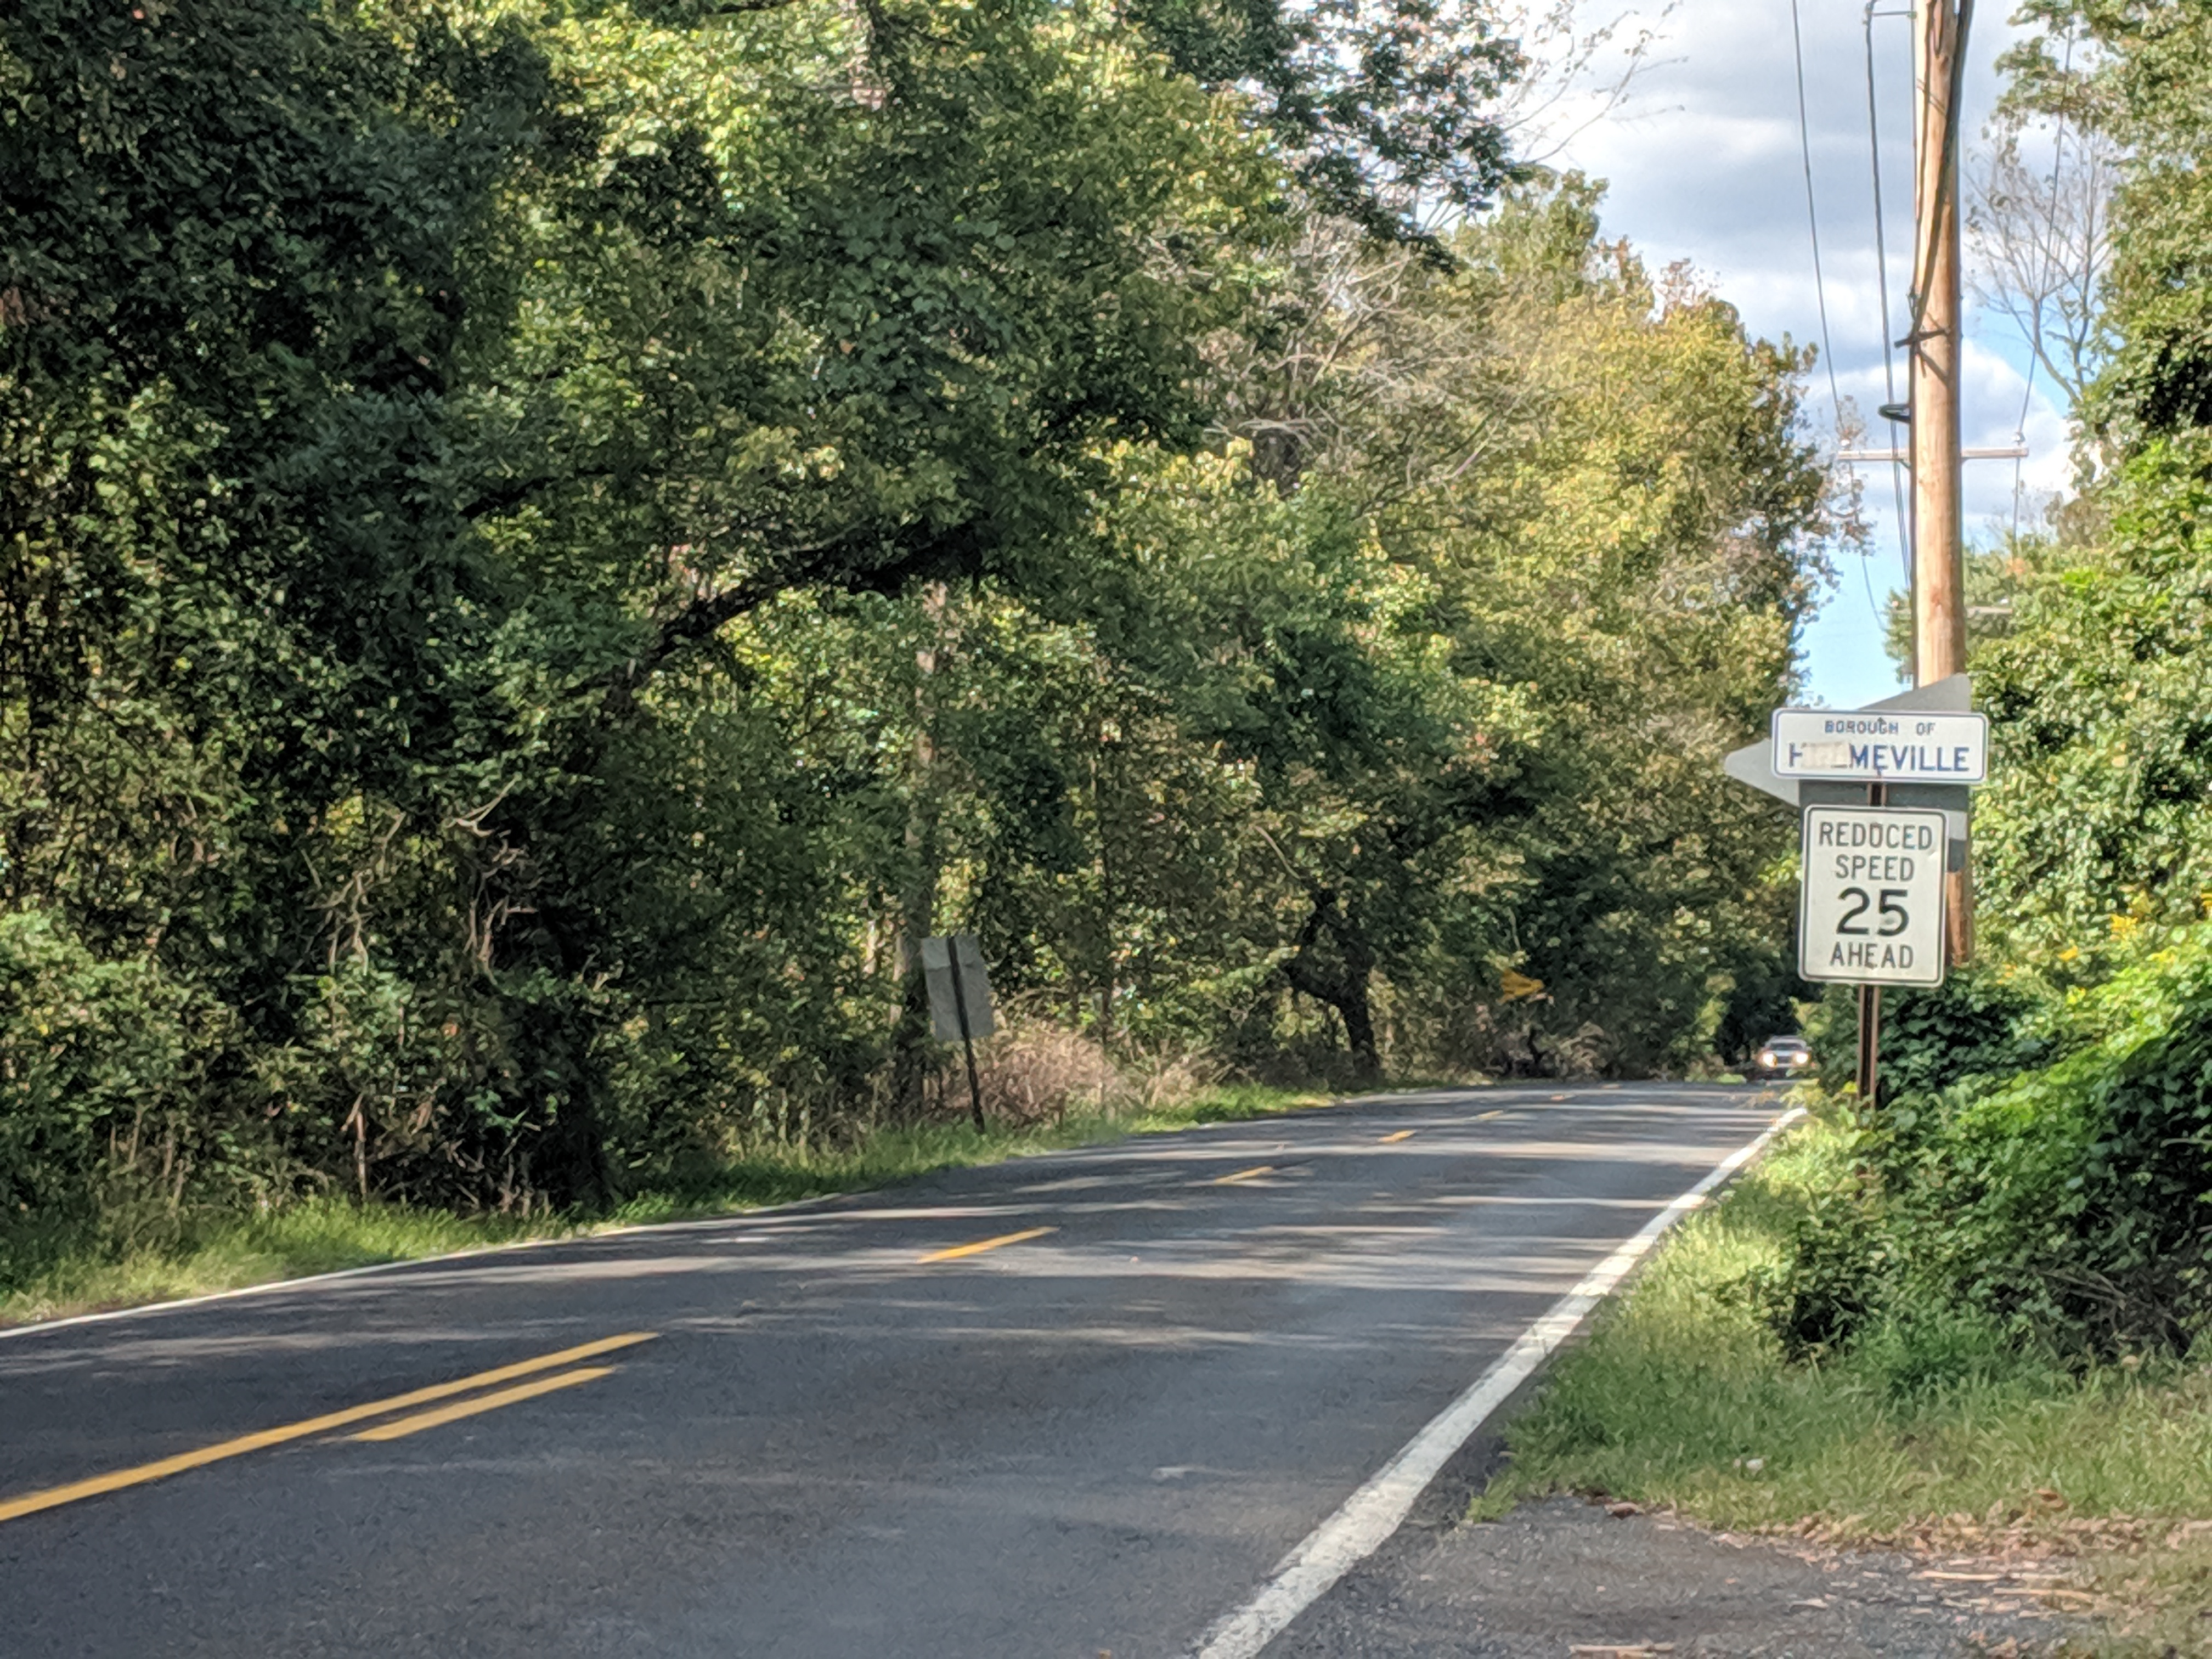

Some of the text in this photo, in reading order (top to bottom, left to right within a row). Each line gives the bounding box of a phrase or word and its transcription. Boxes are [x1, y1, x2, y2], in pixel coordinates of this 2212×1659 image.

[1825, 720, 1936, 736] BOROUGH OF
[1789, 743, 1970, 772] HMEVILLE
[1819, 822, 1933, 850] REDUCED
[1836, 854, 1915, 882] SPEED
[1836, 887, 1909, 936] 25
[1830, 941, 1914, 969] AHEAD
